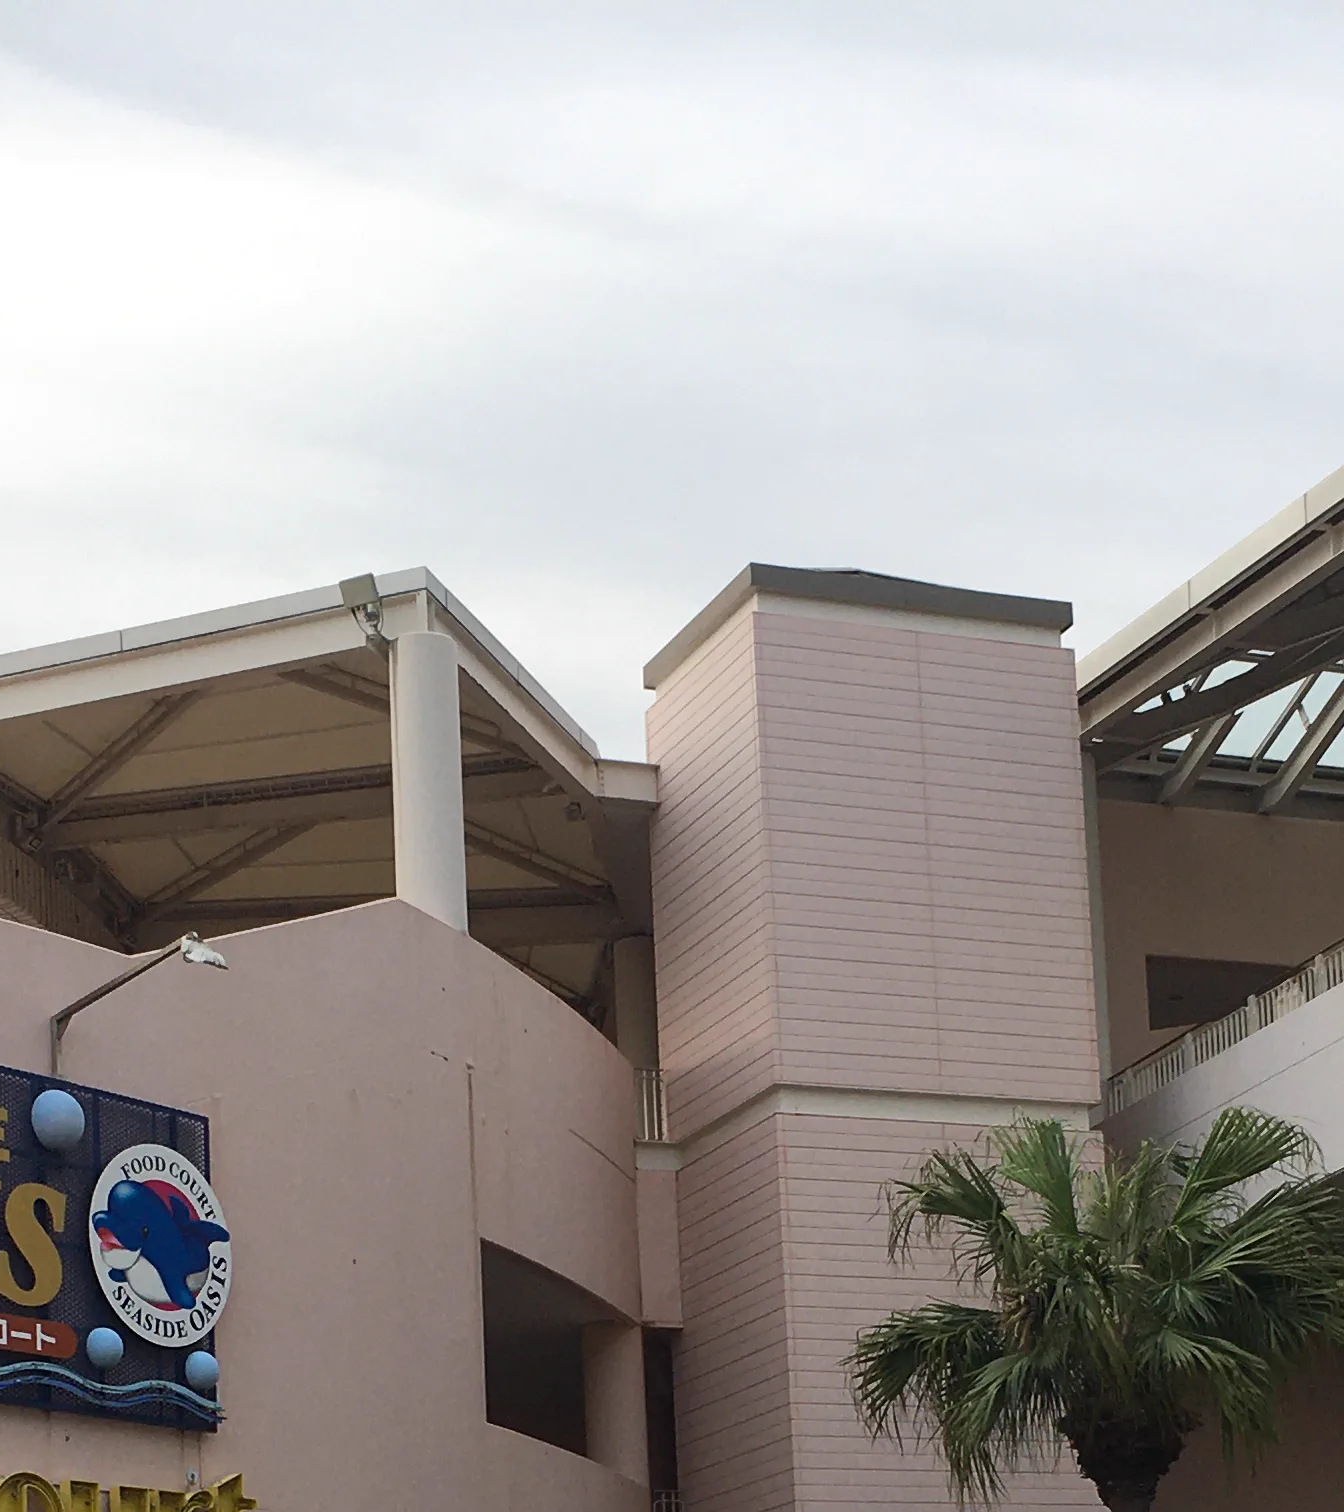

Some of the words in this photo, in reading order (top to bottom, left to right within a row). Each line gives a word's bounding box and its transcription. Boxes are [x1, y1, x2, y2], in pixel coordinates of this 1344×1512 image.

[119, 1155, 166, 1179] FOOD
[169, 1162, 216, 1220] COURT
[112, 1286, 188, 1339] SEASIDE
[189, 1255, 228, 1331] OASIS
